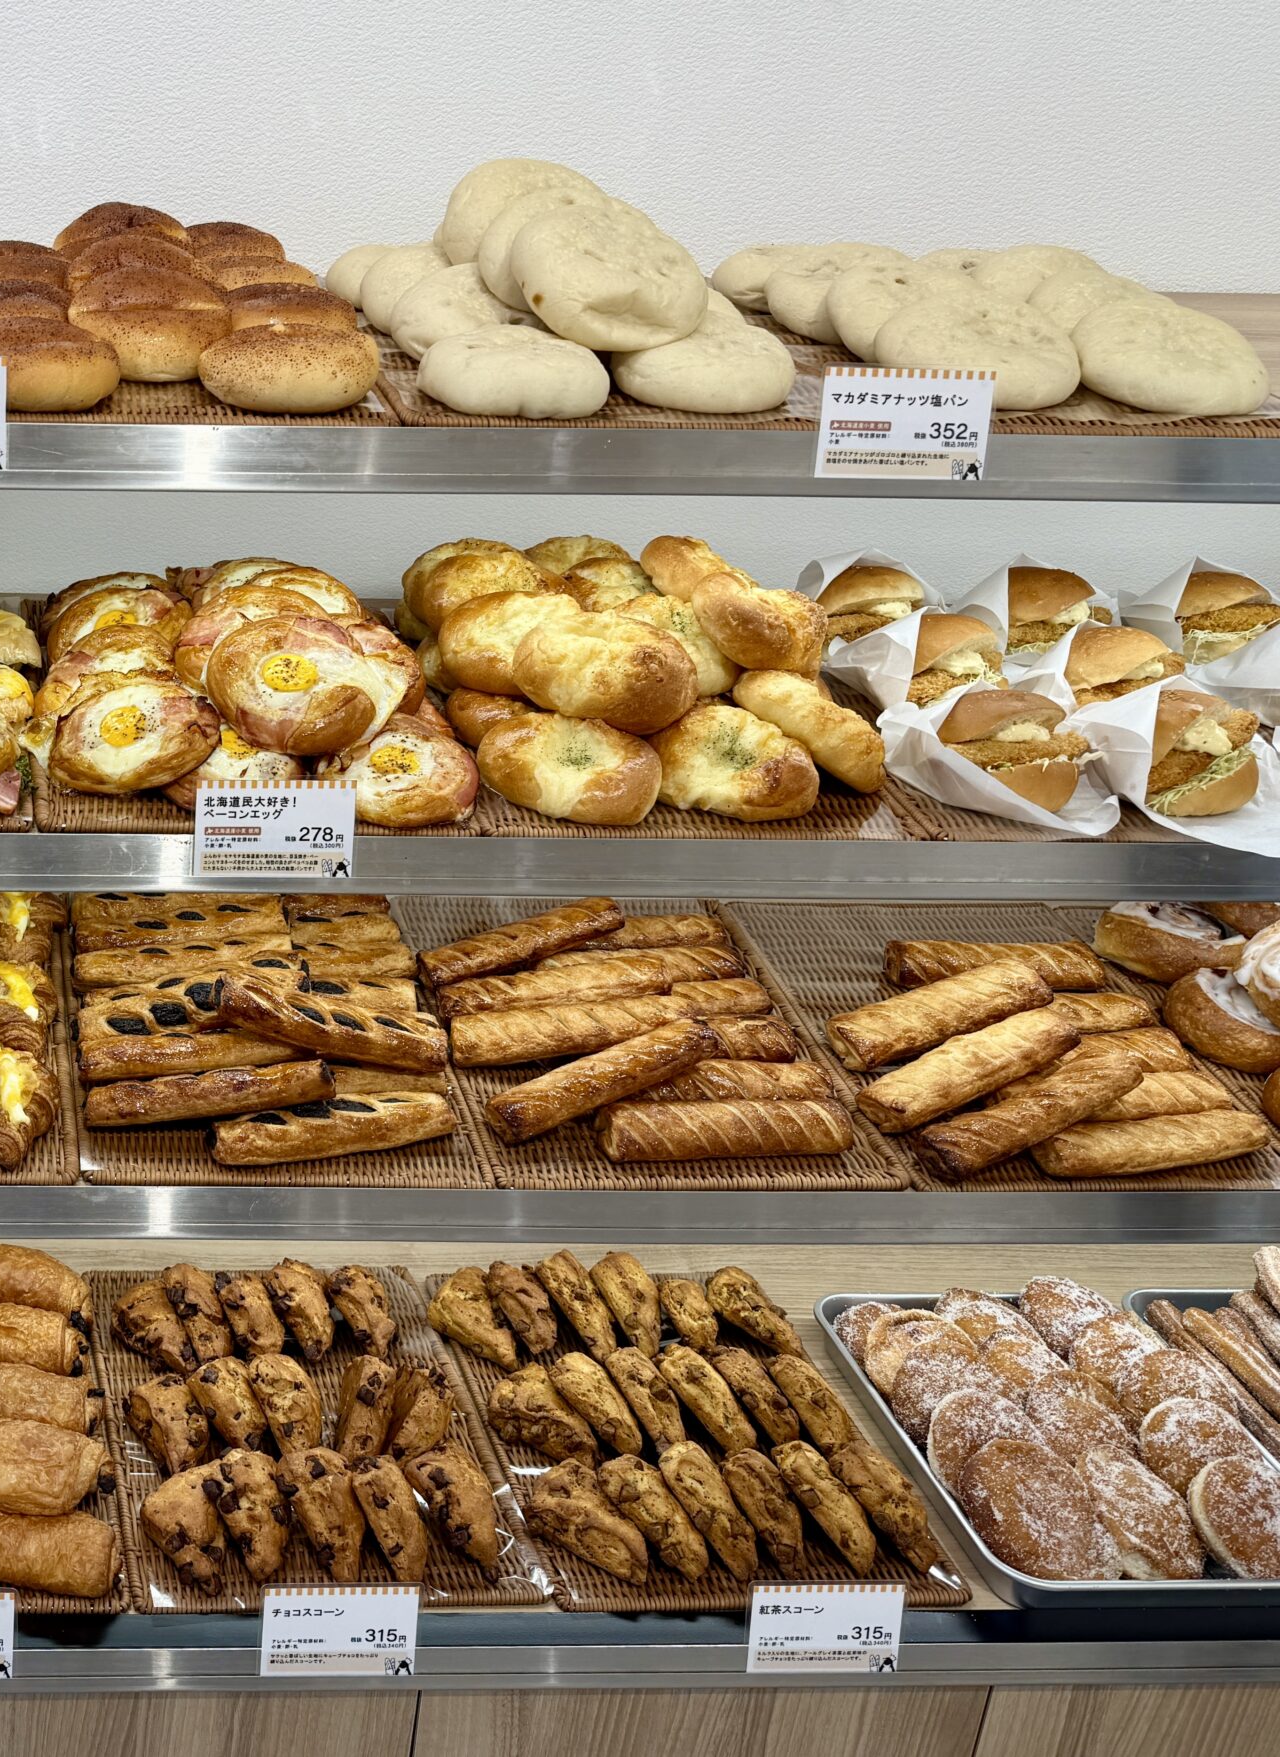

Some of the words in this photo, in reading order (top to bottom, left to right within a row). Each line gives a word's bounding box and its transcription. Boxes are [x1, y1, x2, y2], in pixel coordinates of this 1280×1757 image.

[831, 392, 969, 407] マカダミアナッツ塩パン
[204, 796, 297, 808] 北海道民大好き!
[204, 808, 284, 820] ベーコンエッグ
[272, 1608, 345, 1617] チョコスコーン
[758, 1604, 824, 1615] 紅茶スコーン
